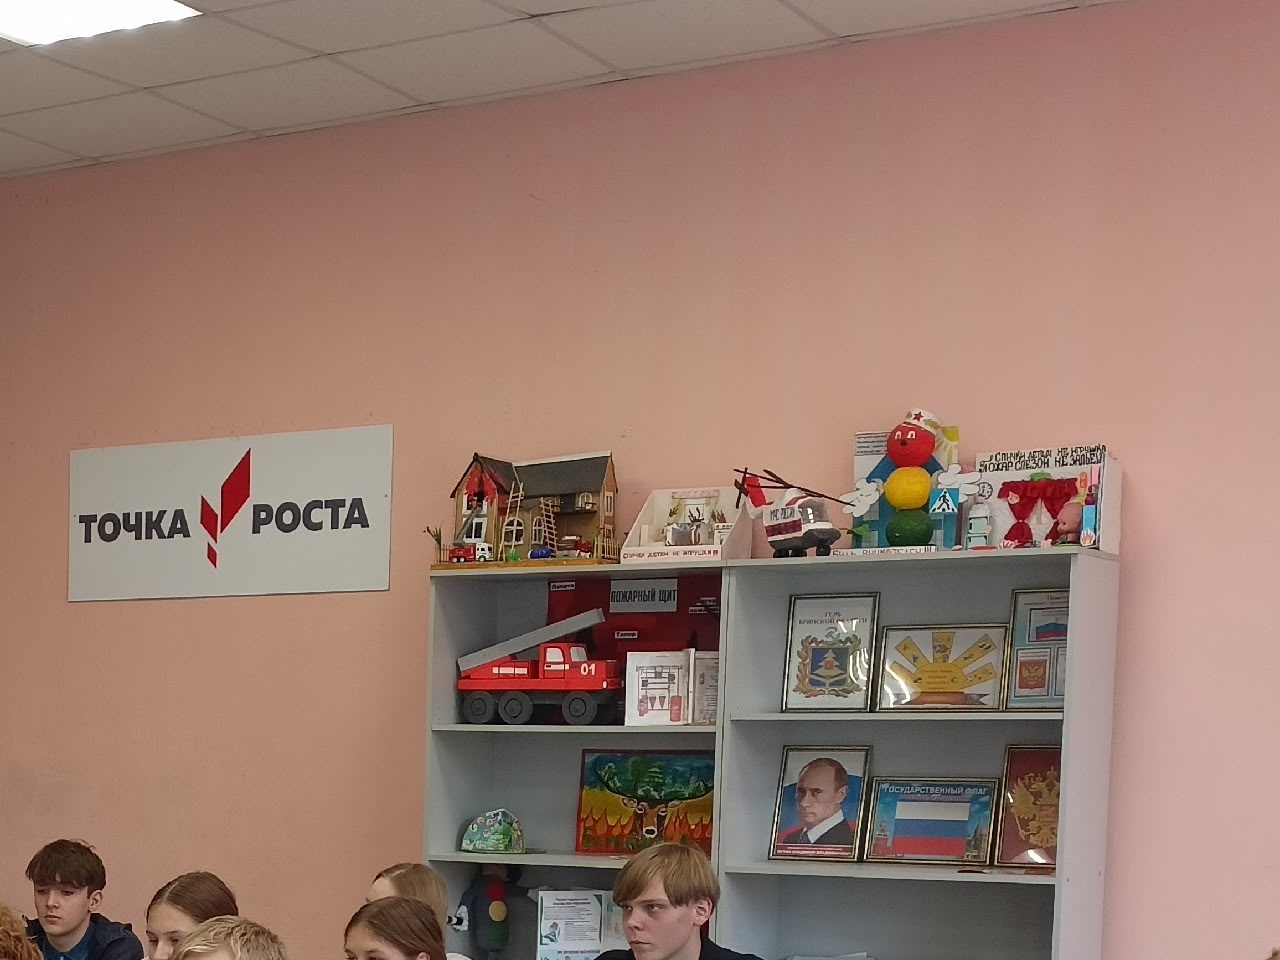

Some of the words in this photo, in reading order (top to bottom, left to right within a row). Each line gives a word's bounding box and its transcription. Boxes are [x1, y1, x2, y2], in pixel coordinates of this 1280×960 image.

[78, 508, 191, 543] ТОЧКА
[252, 497, 370, 534] РОСТА
[610, 588, 656, 603] ПОЖАРНЫЙ
[658, 588, 678, 604] ЩИТ
[580, 663, 596, 676] 01
[884, 785, 964, 795] ГОСУДАРСТВЕННЫЙ
